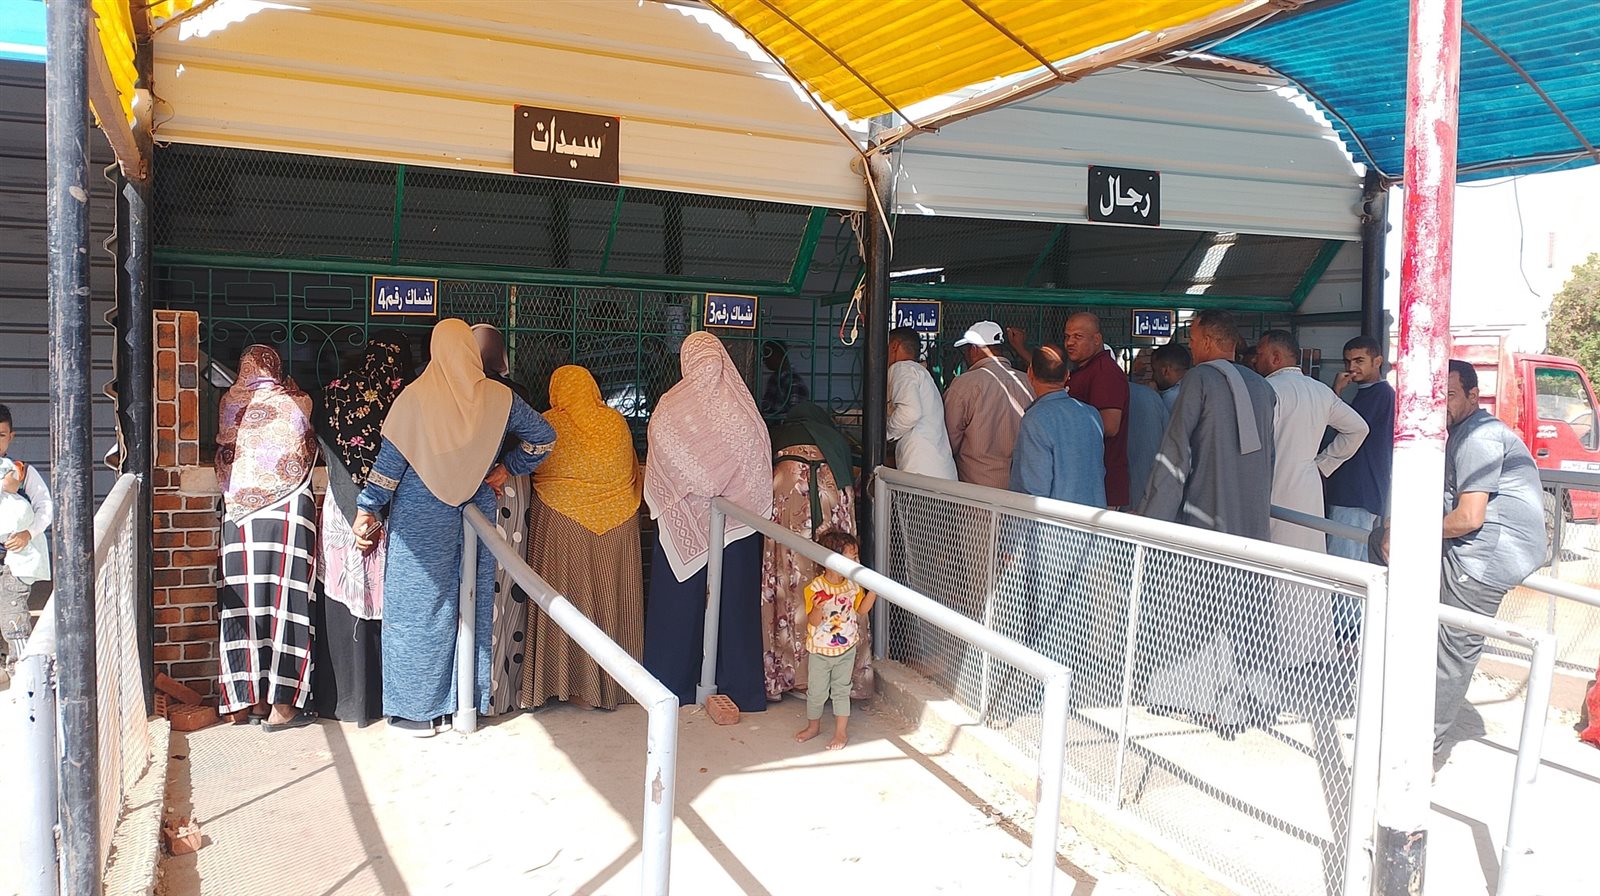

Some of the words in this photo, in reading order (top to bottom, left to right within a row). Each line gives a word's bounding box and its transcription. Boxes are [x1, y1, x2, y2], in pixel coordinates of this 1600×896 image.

[531, 115, 602, 169] سيدات
[1100, 174, 1151, 218] رجال
[730, 304, 753, 325] شباك
[916, 309, 937, 331] شباك
[1151, 315, 1170, 335] شباك
